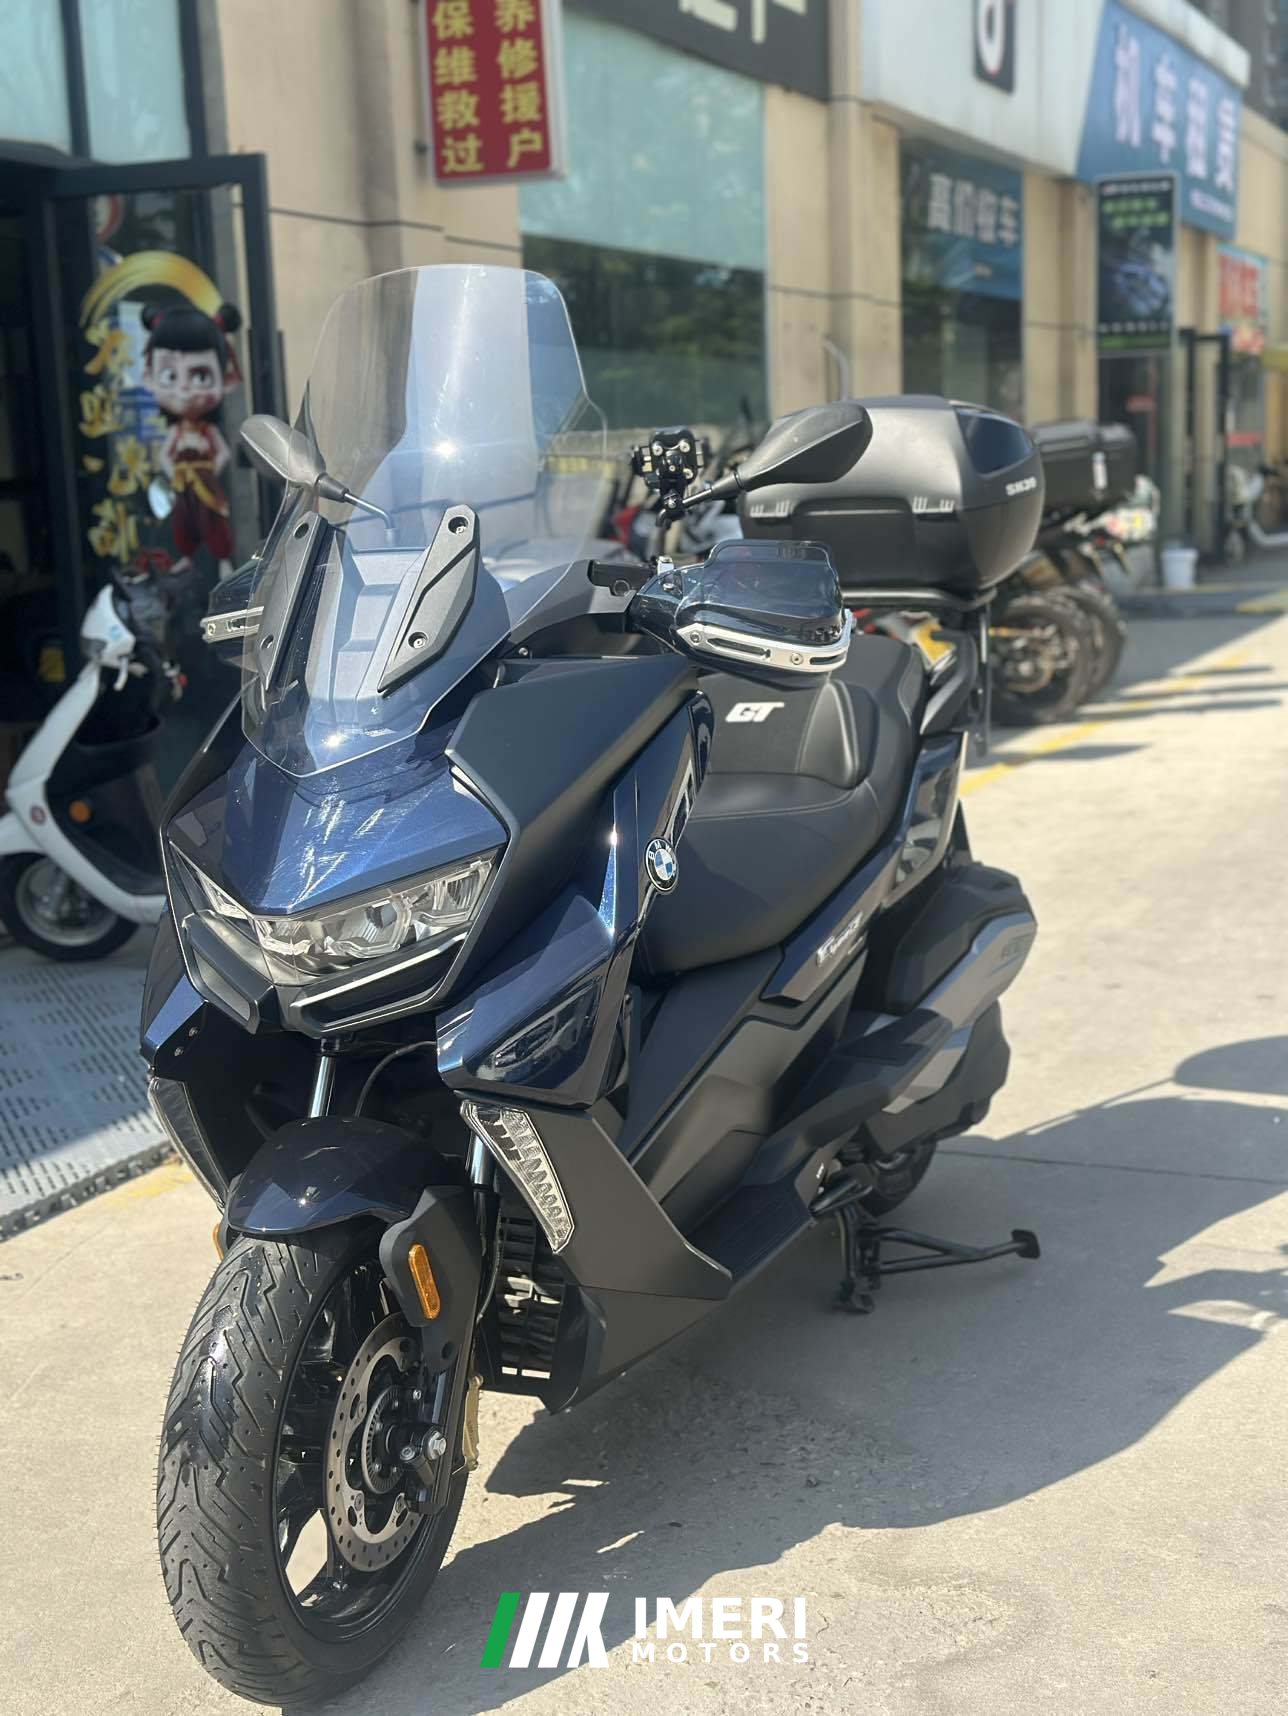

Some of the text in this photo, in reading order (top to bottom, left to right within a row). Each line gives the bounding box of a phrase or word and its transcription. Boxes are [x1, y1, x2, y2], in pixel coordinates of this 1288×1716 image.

[432, 0, 535, 40] 保养
[434, 37, 538, 86] 维修
[437, 81, 542, 130] 救援
[441, 127, 544, 174] 过户
[725, 702, 785, 722] GT
